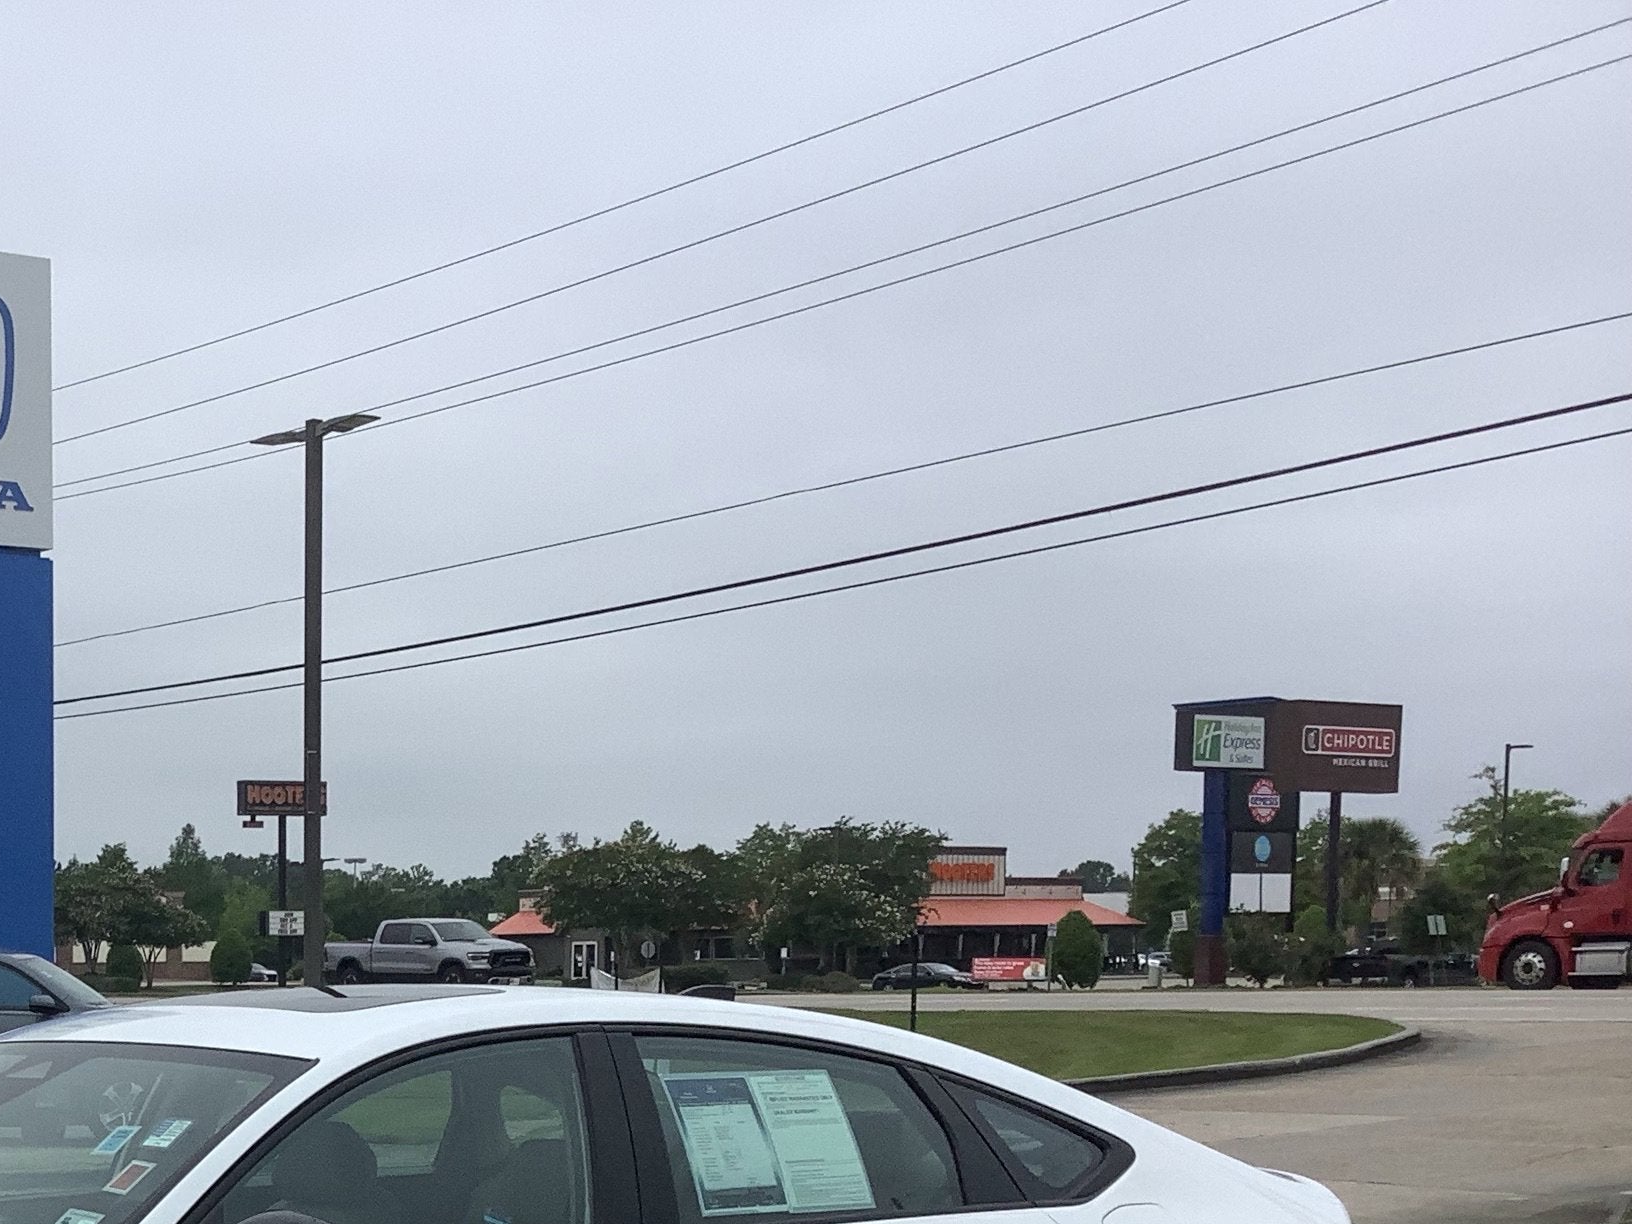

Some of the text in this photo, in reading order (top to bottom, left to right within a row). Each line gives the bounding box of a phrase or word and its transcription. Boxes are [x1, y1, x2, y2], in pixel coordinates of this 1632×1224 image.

[1223, 733, 1261, 752] Express
[1323, 733, 1391, 750] CHIPOTLE
[1332, 758, 1389, 768] MEXICAN GRILL
[246, 784, 325, 805] HOOTE
